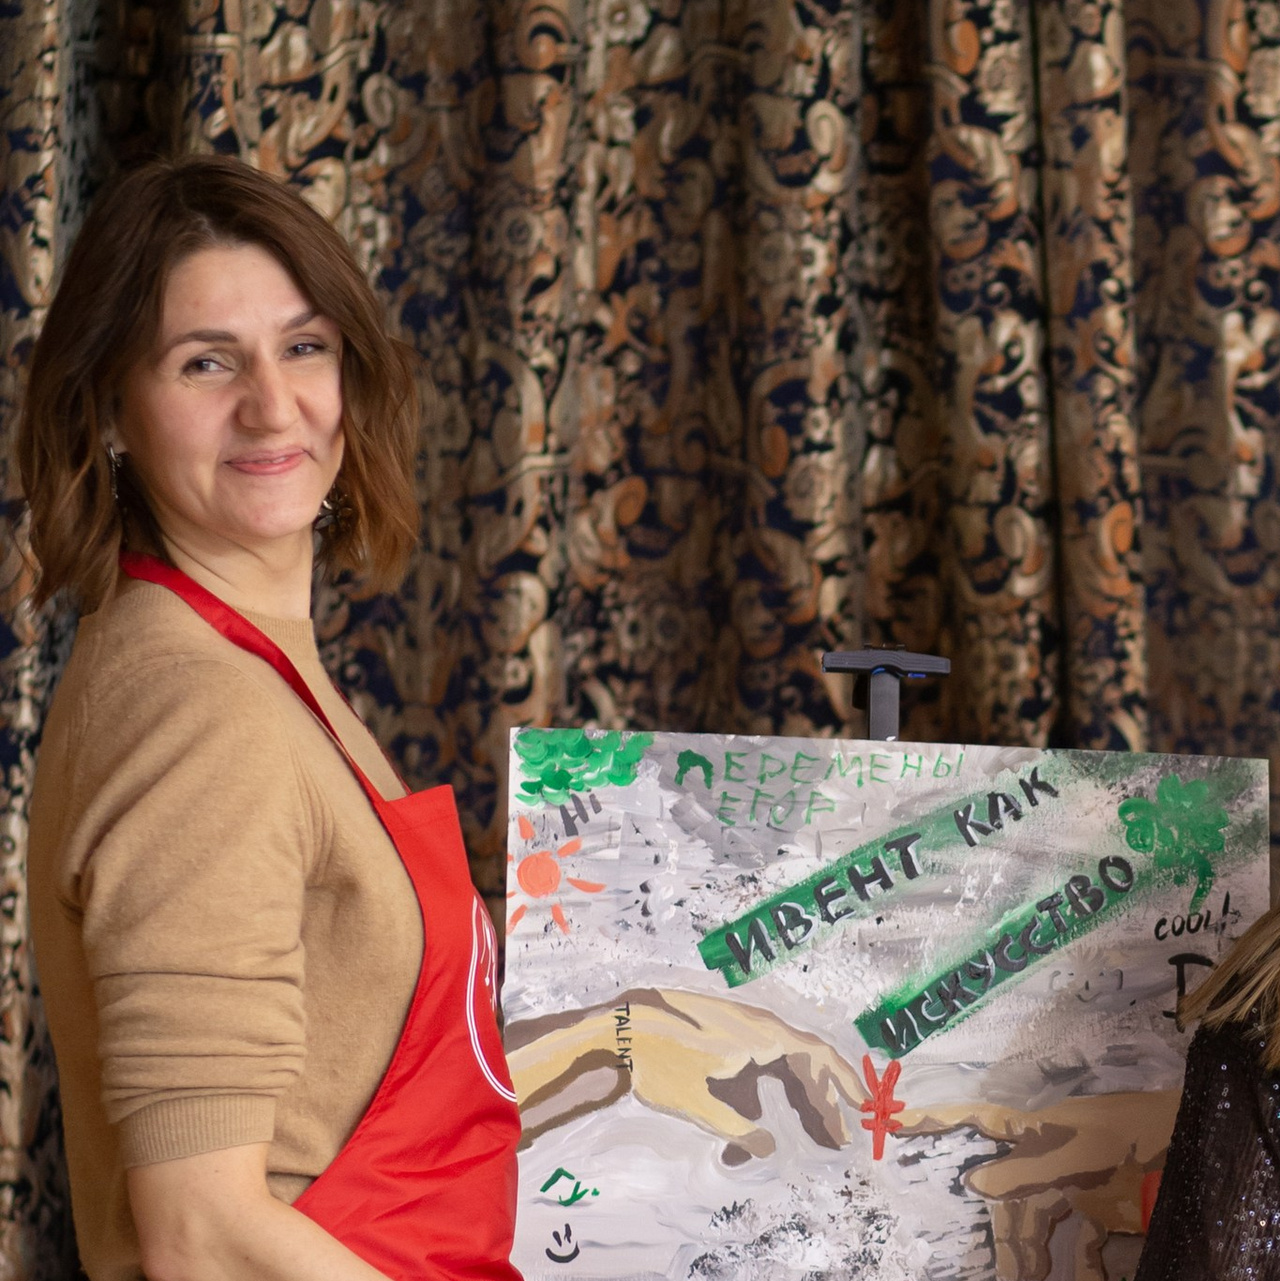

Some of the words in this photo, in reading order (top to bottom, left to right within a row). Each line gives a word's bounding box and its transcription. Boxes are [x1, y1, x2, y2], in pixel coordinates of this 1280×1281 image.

[675, 748, 965, 790] ПЕРЕМЕНЫ
[715, 790, 837, 827] ЕГОР
[724, 832, 923, 975] ИВЕНТ
[953, 766, 1060, 847] КАК
[878, 854, 1135, 1054] ИСКУССТВО
[613, 1001, 633, 1072] TALENT
